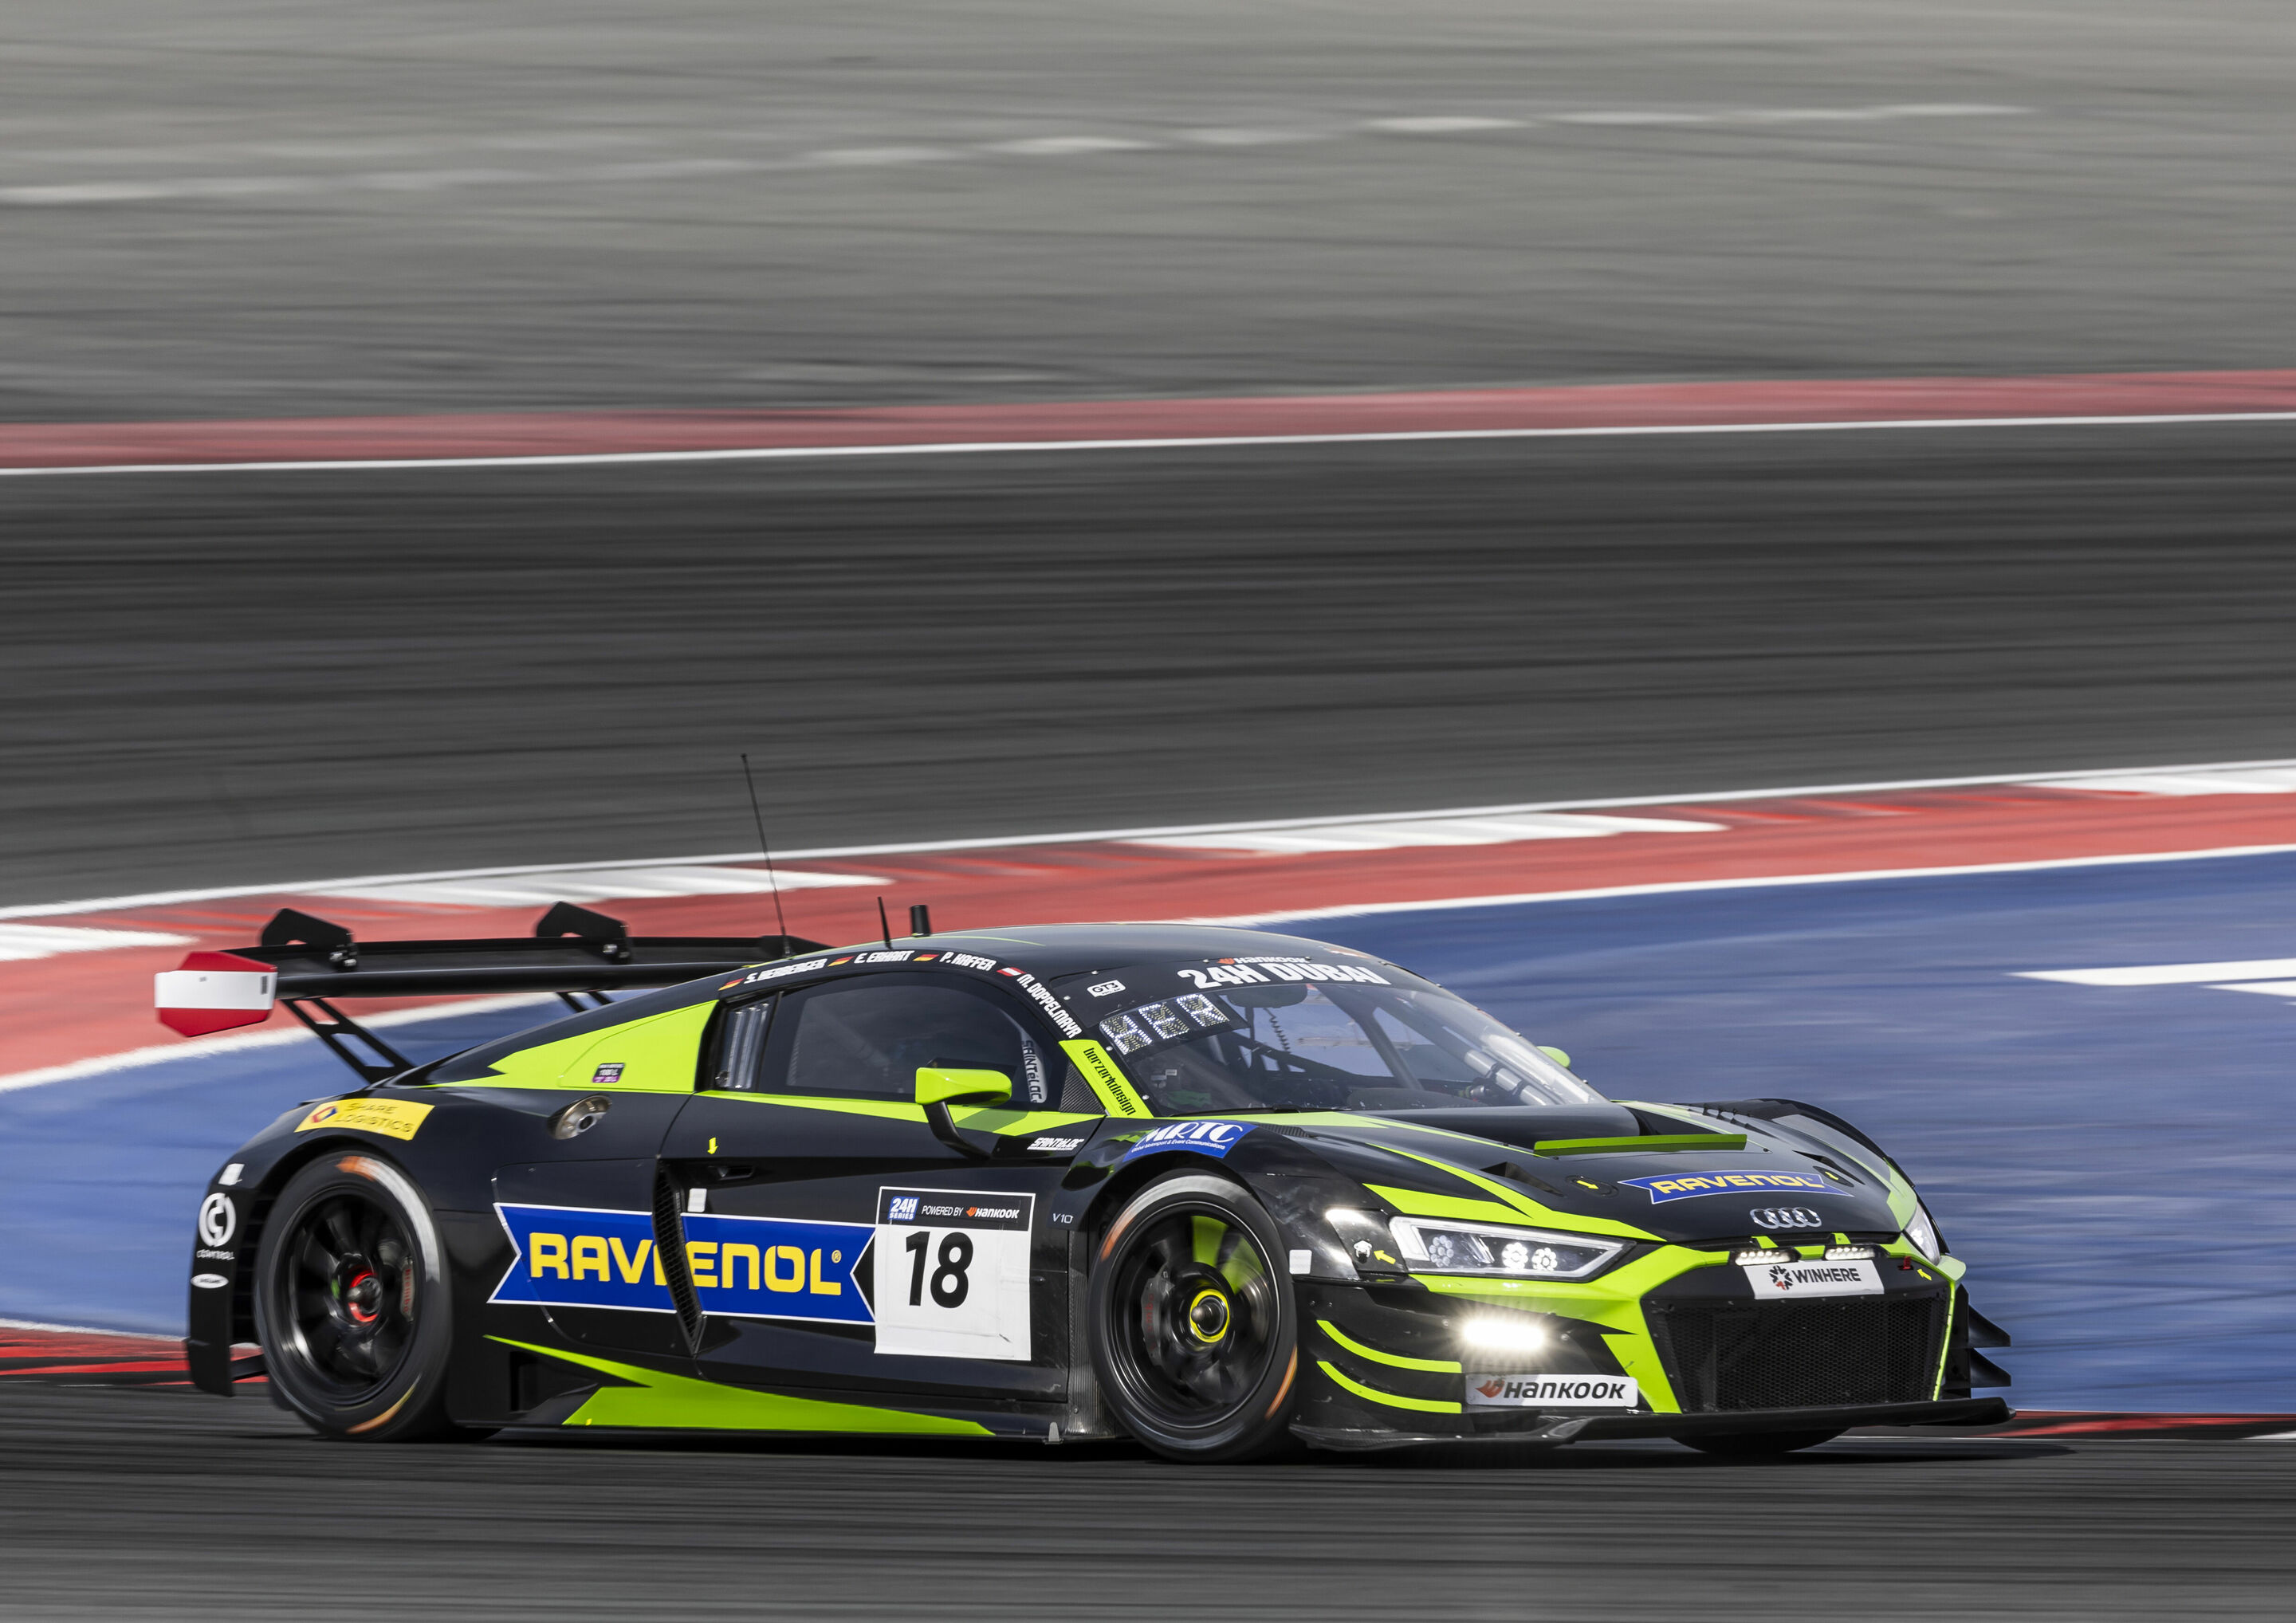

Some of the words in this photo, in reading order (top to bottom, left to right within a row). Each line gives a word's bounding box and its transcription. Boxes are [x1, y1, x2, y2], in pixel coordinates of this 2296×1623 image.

[1177, 963, 1271, 989] 24H
[1258, 962, 1392, 985] DUBAI
[1092, 982, 1119, 993] GT3
[1026, 982, 1083, 1039] DOPPELMAYR
[1083, 1047, 1136, 1116] berzerkdesign
[335, 1114, 415, 1132] LOGISTICS
[1185, 1139, 1225, 1150] Communications
[890, 1198, 917, 1212] 24H
[921, 1204, 953, 1216] POWERED
[953, 1207, 964, 1216] BY
[889, 1211, 914, 1220] SERIES
[1052, 1212, 1074, 1224] V10
[906, 1230, 974, 1309] 18
[1792, 1267, 1862, 1284] WINHERE
